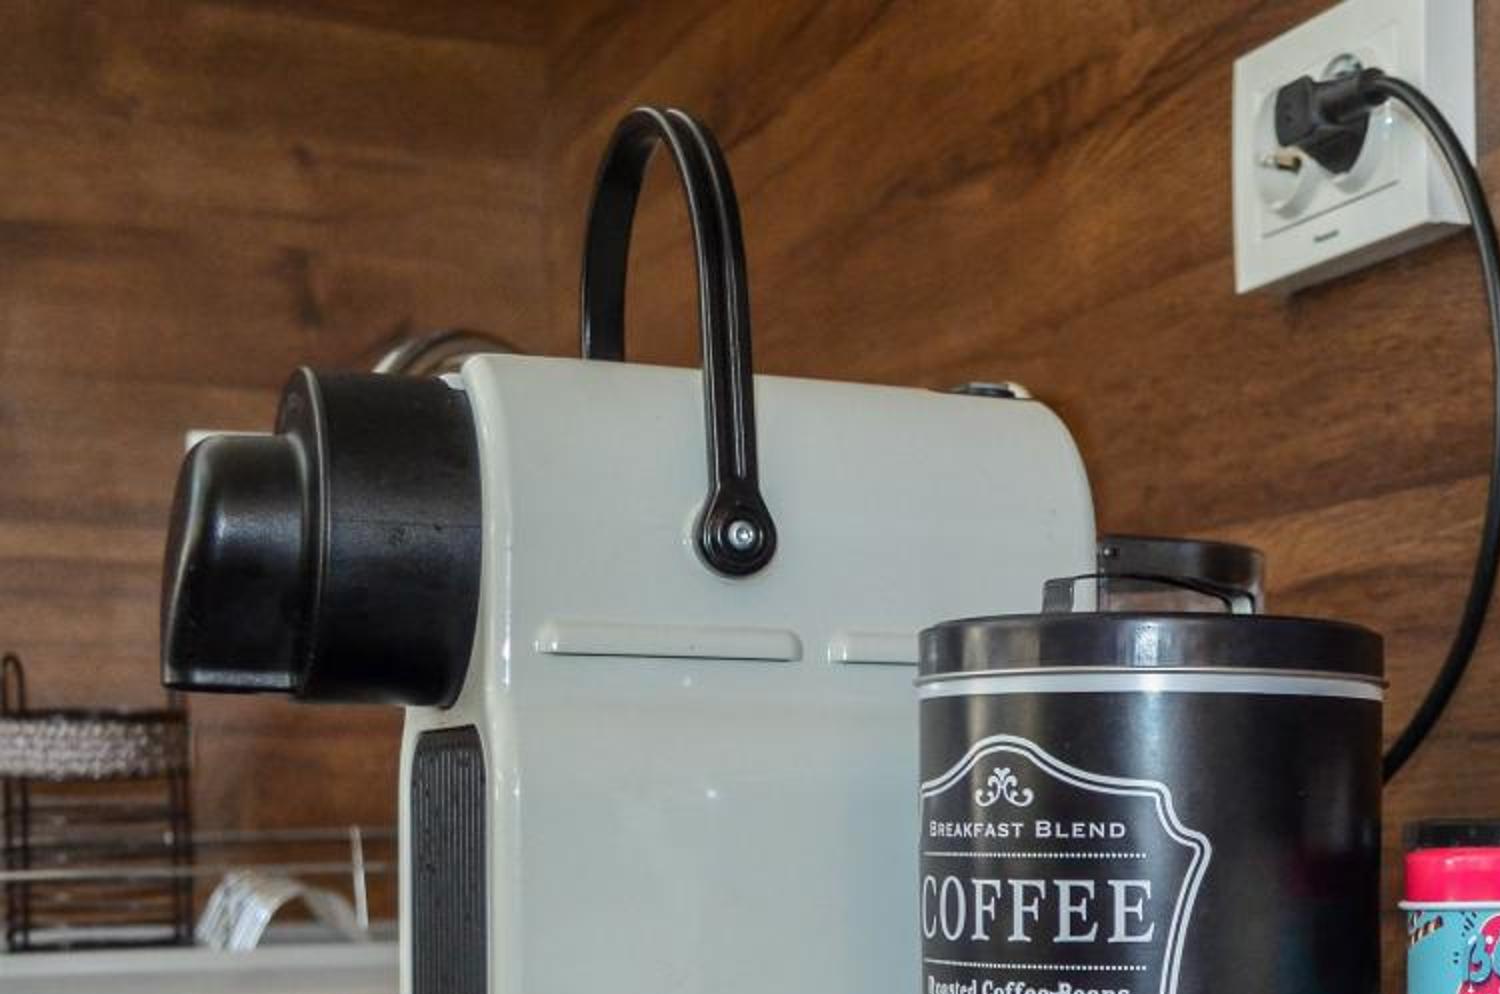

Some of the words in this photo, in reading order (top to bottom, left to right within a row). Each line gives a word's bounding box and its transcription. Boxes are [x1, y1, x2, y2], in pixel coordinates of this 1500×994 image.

[929, 820, 1024, 838] BREAKFAST
[1035, 820, 1126, 838] BLEND
[922, 875, 1155, 943] COFFEE
